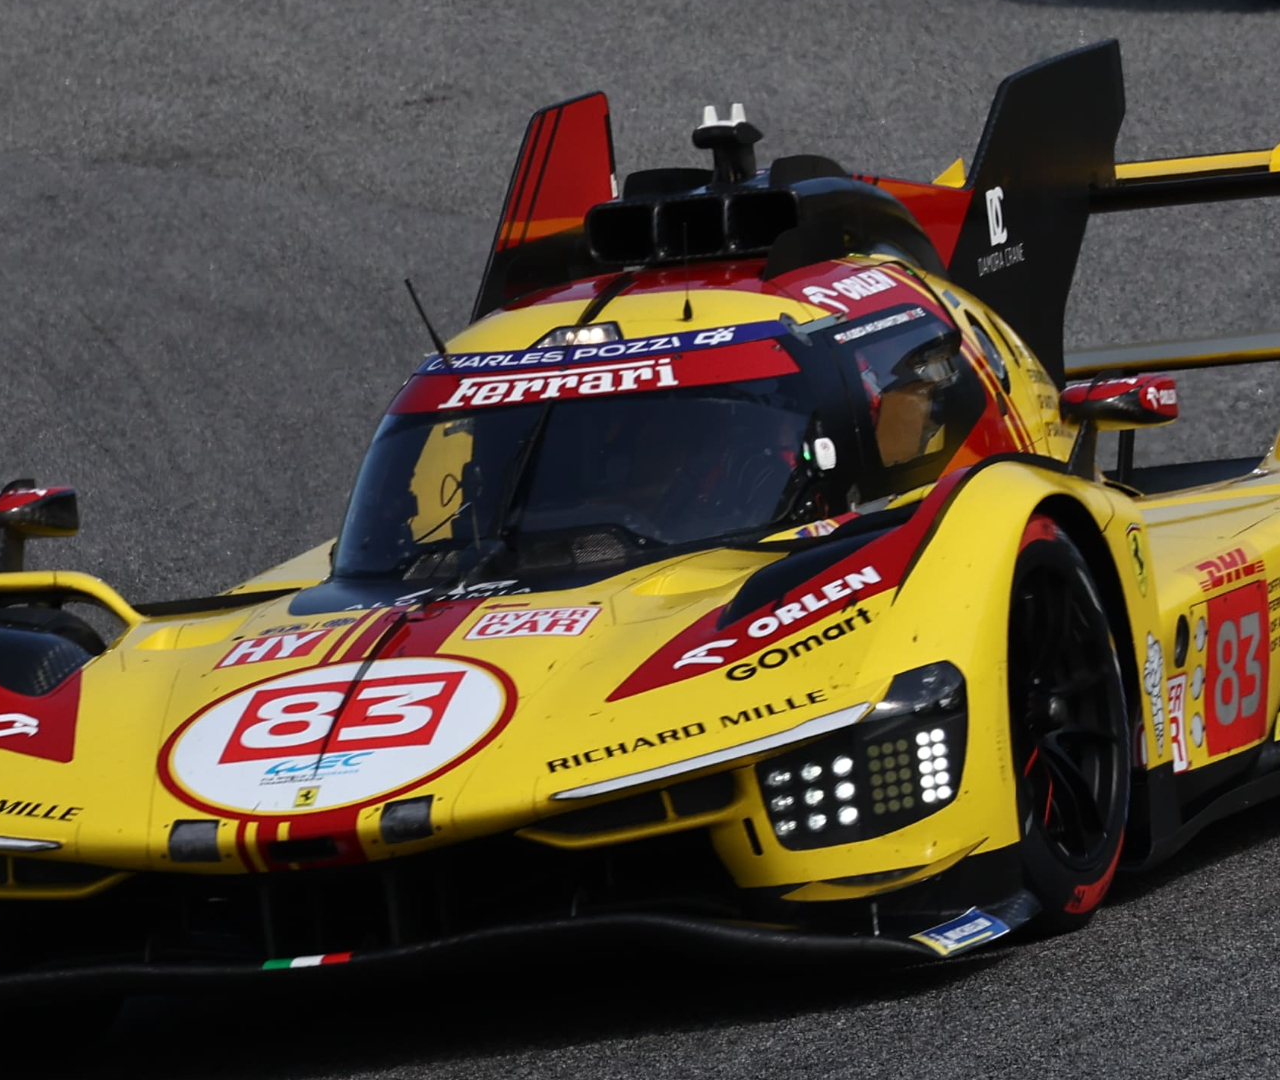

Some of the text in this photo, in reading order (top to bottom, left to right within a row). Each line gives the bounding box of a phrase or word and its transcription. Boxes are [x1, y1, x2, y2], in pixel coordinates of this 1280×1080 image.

[832, 269, 898, 300] ORLEN
[426, 350, 565, 372] CHARLES
[573, 336, 682, 361] POZZI
[437, 358, 680, 410] Ferrari
[1195, 547, 1266, 593] DHL
[486, 609, 590, 623] HYPER
[746, 565, 883, 639] ORLEN
[219, 629, 327, 668] HY
[476, 618, 581, 636] CAR
[724, 607, 874, 682] GOmart
[1214, 611, 1262, 727] 83
[240, 682, 445, 750] 83
[546, 689, 829, 774] RICHARD MILLE
